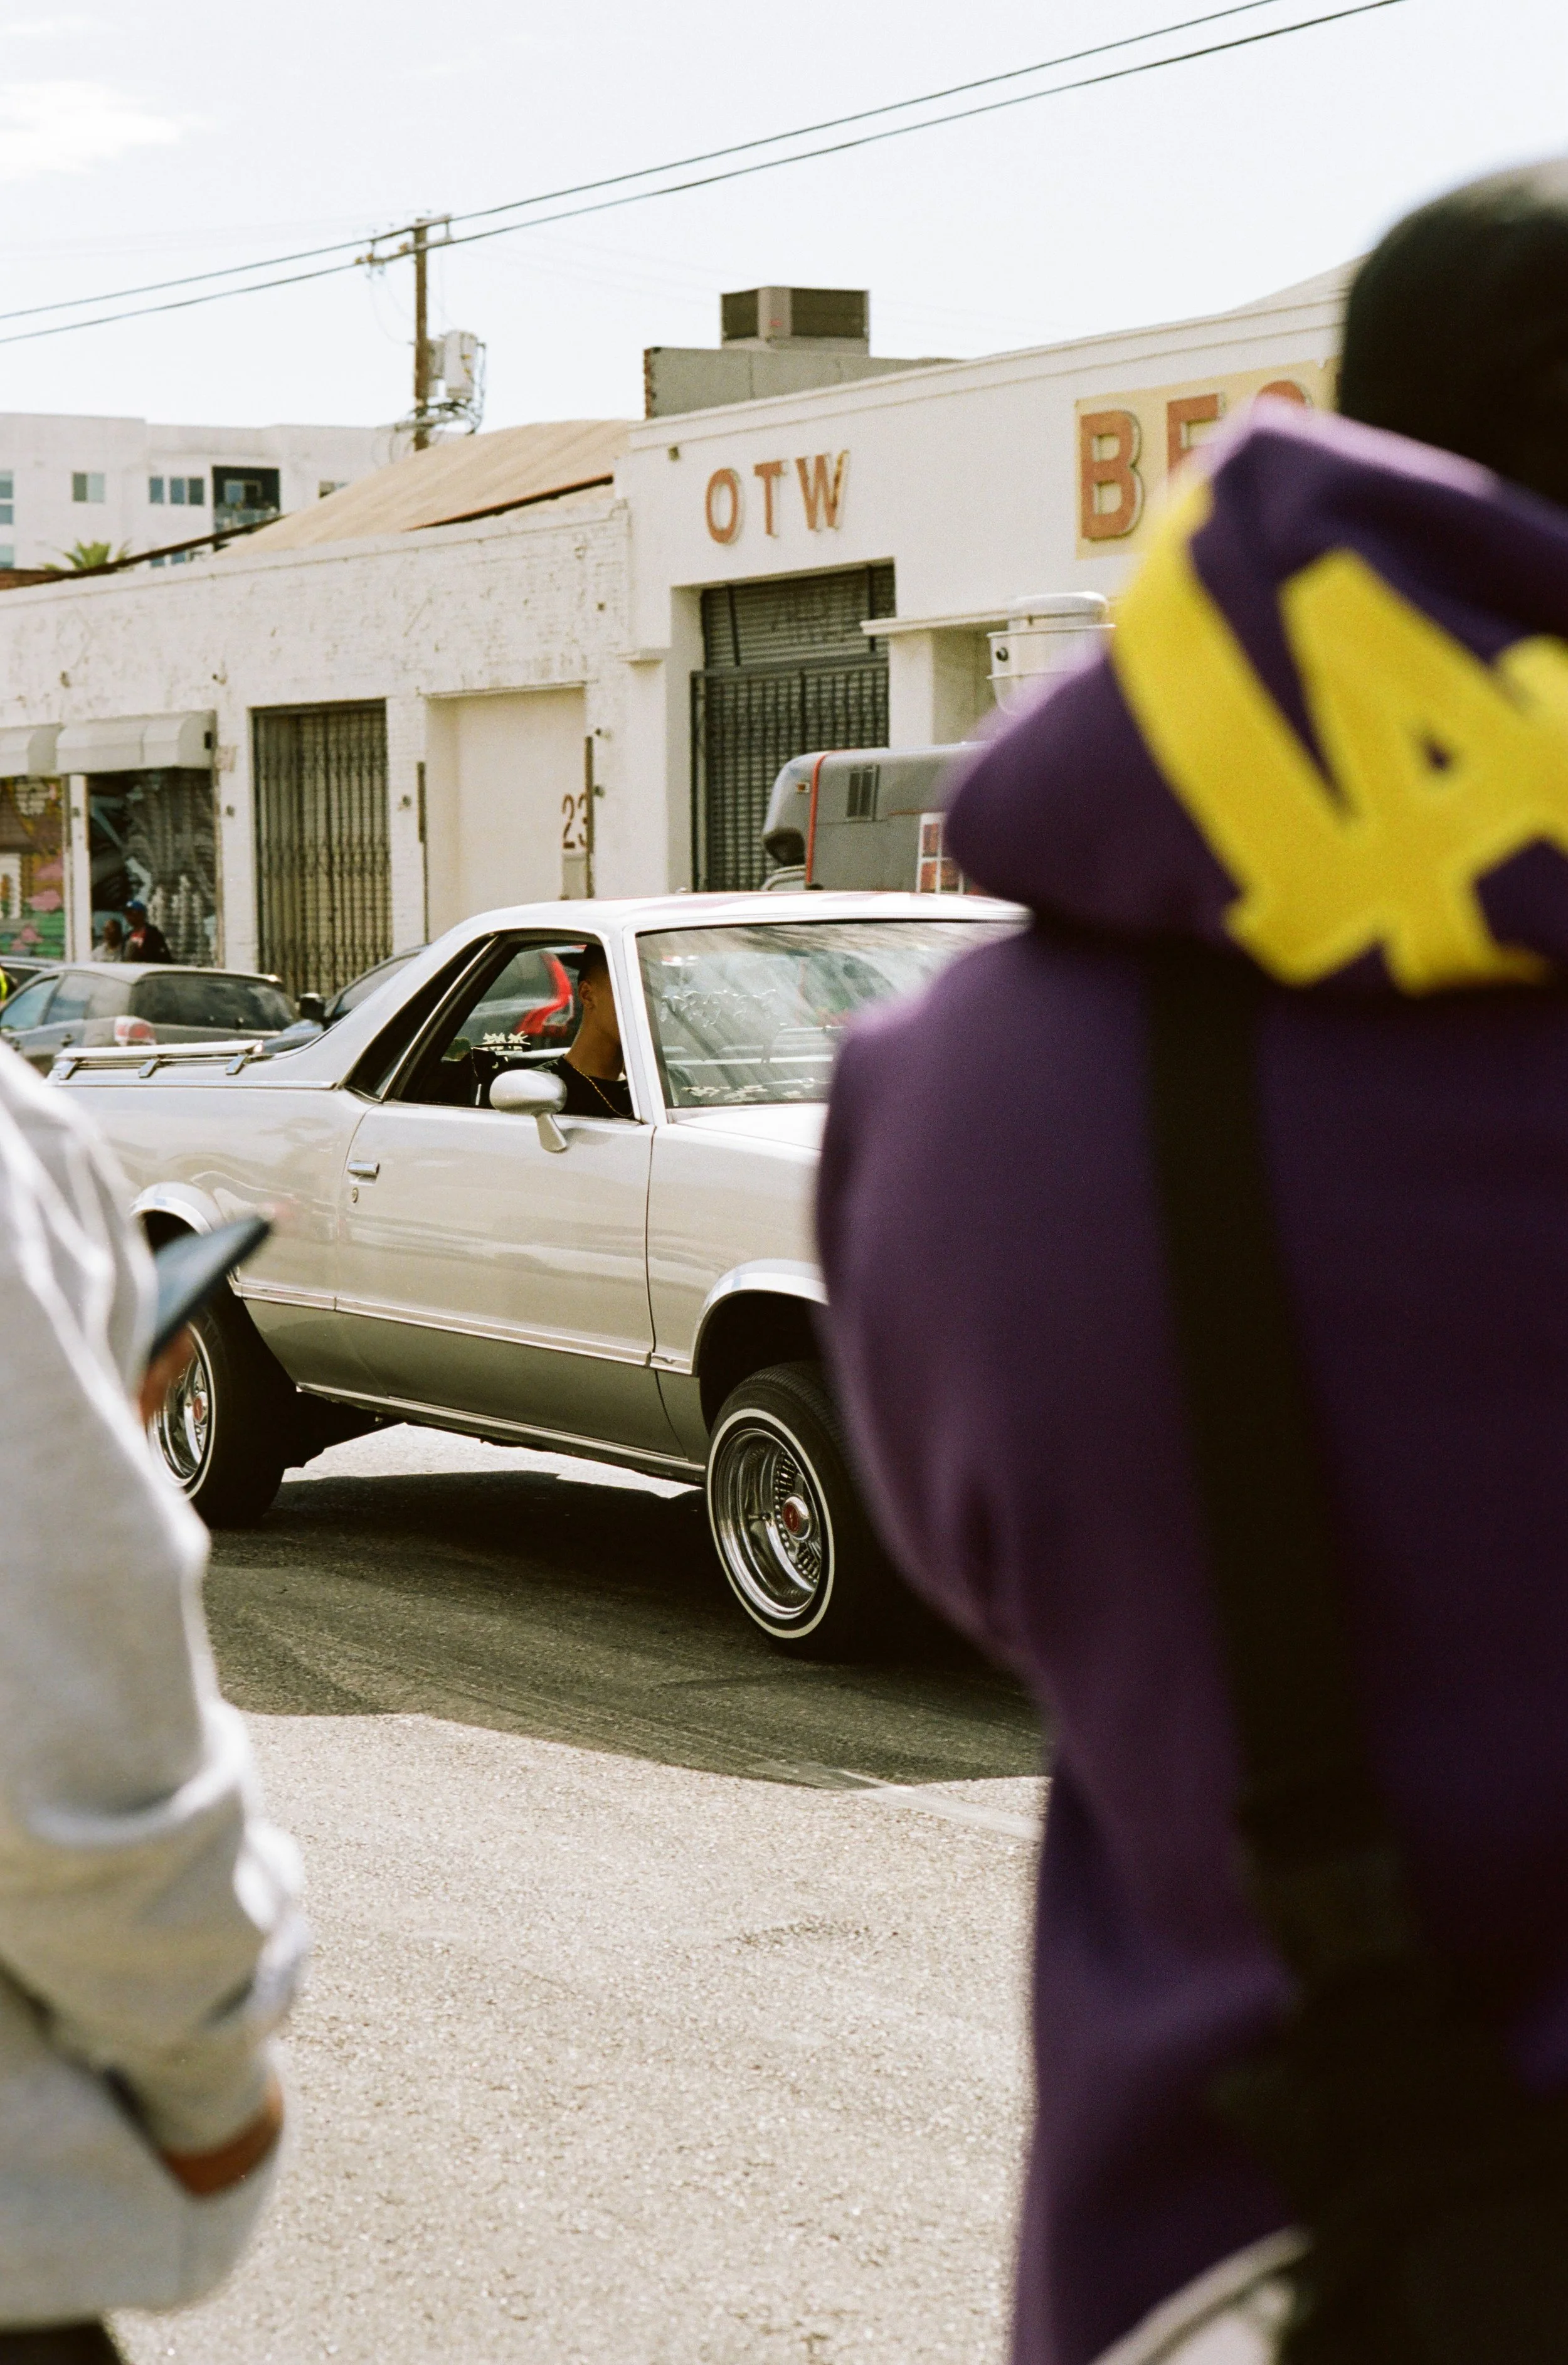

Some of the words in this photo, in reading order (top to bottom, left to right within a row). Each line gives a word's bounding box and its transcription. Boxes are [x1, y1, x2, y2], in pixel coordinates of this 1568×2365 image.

[705, 450, 850, 545] OTW
[1080, 380, 1315, 539] BE
[1111, 477, 1568, 990] LA
